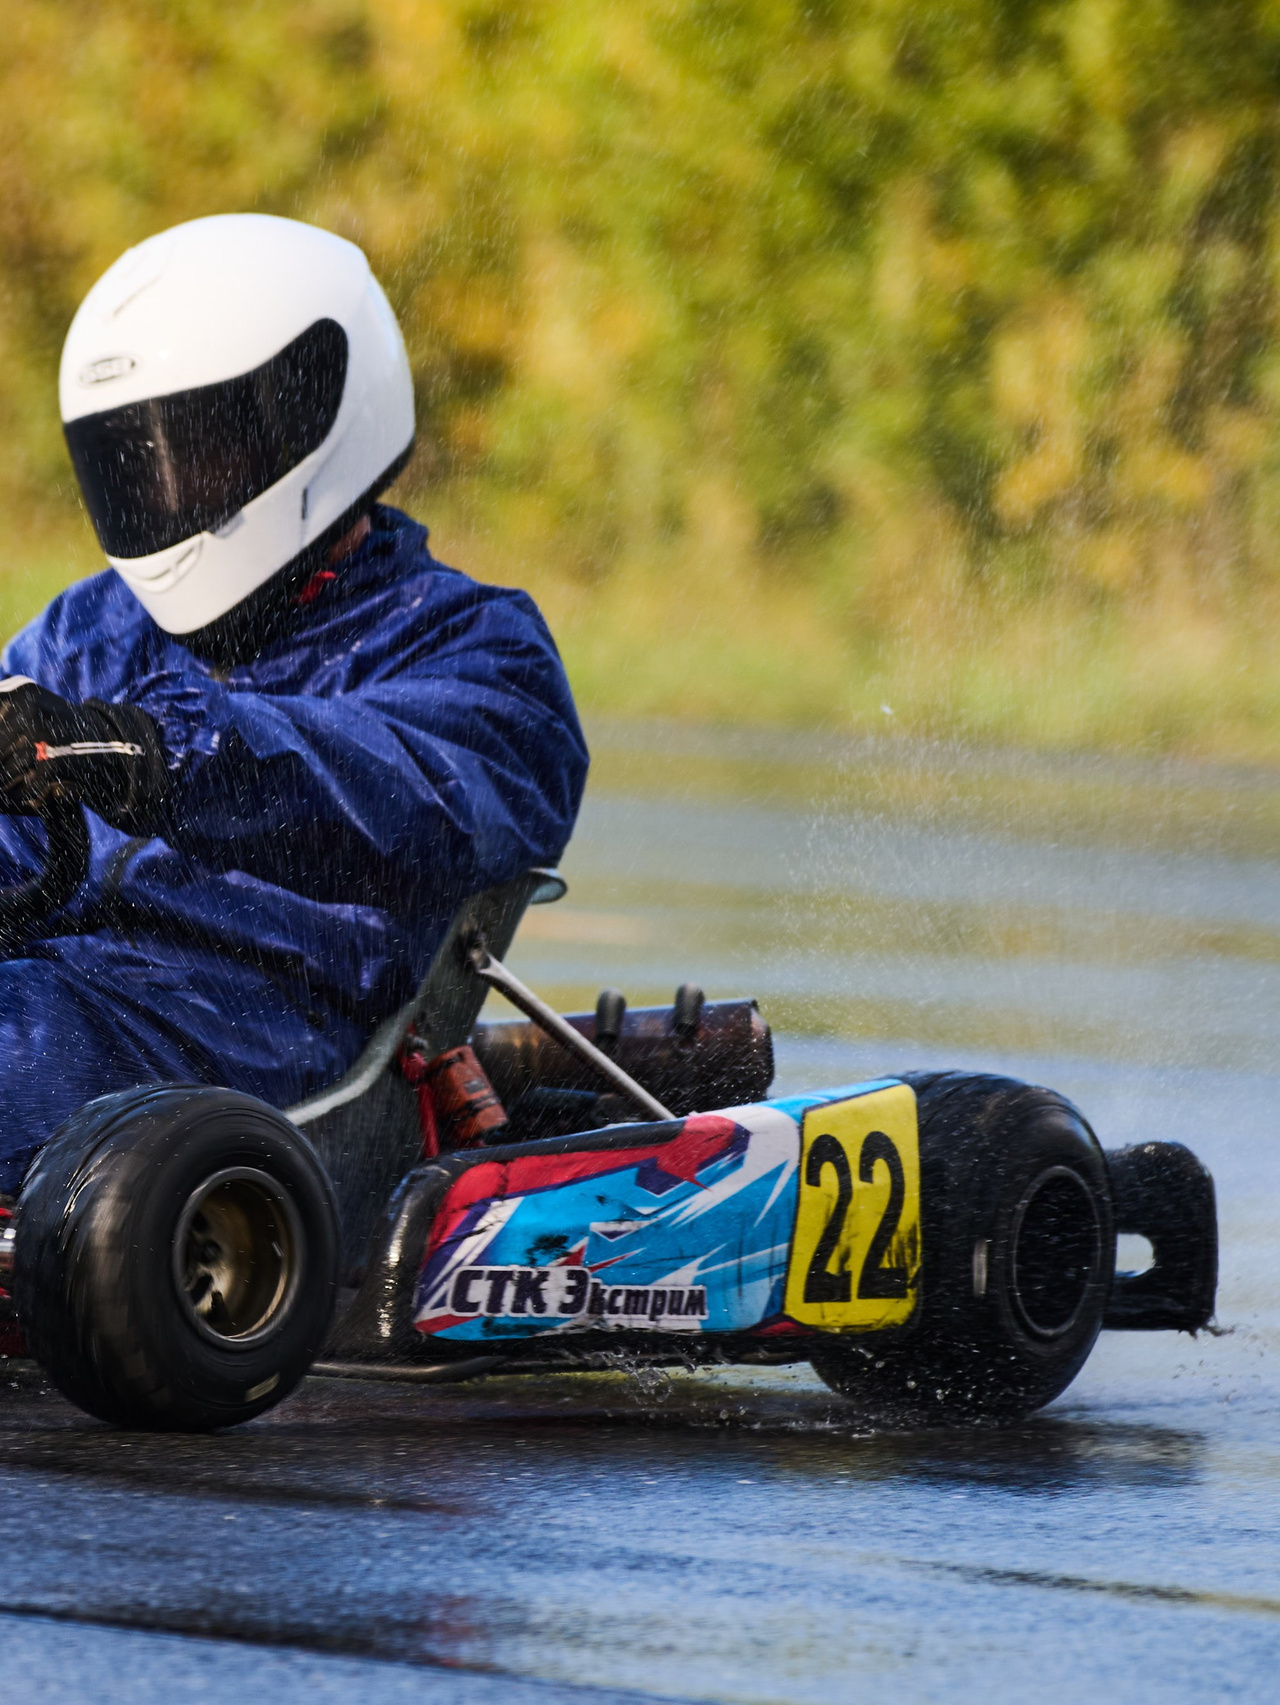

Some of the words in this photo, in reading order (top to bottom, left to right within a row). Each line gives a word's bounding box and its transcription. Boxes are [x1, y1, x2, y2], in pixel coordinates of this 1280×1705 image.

[803, 1131, 908, 1304] 22
[452, 1269, 550, 1314] СТК
[558, 1269, 708, 1322] Экстрим
